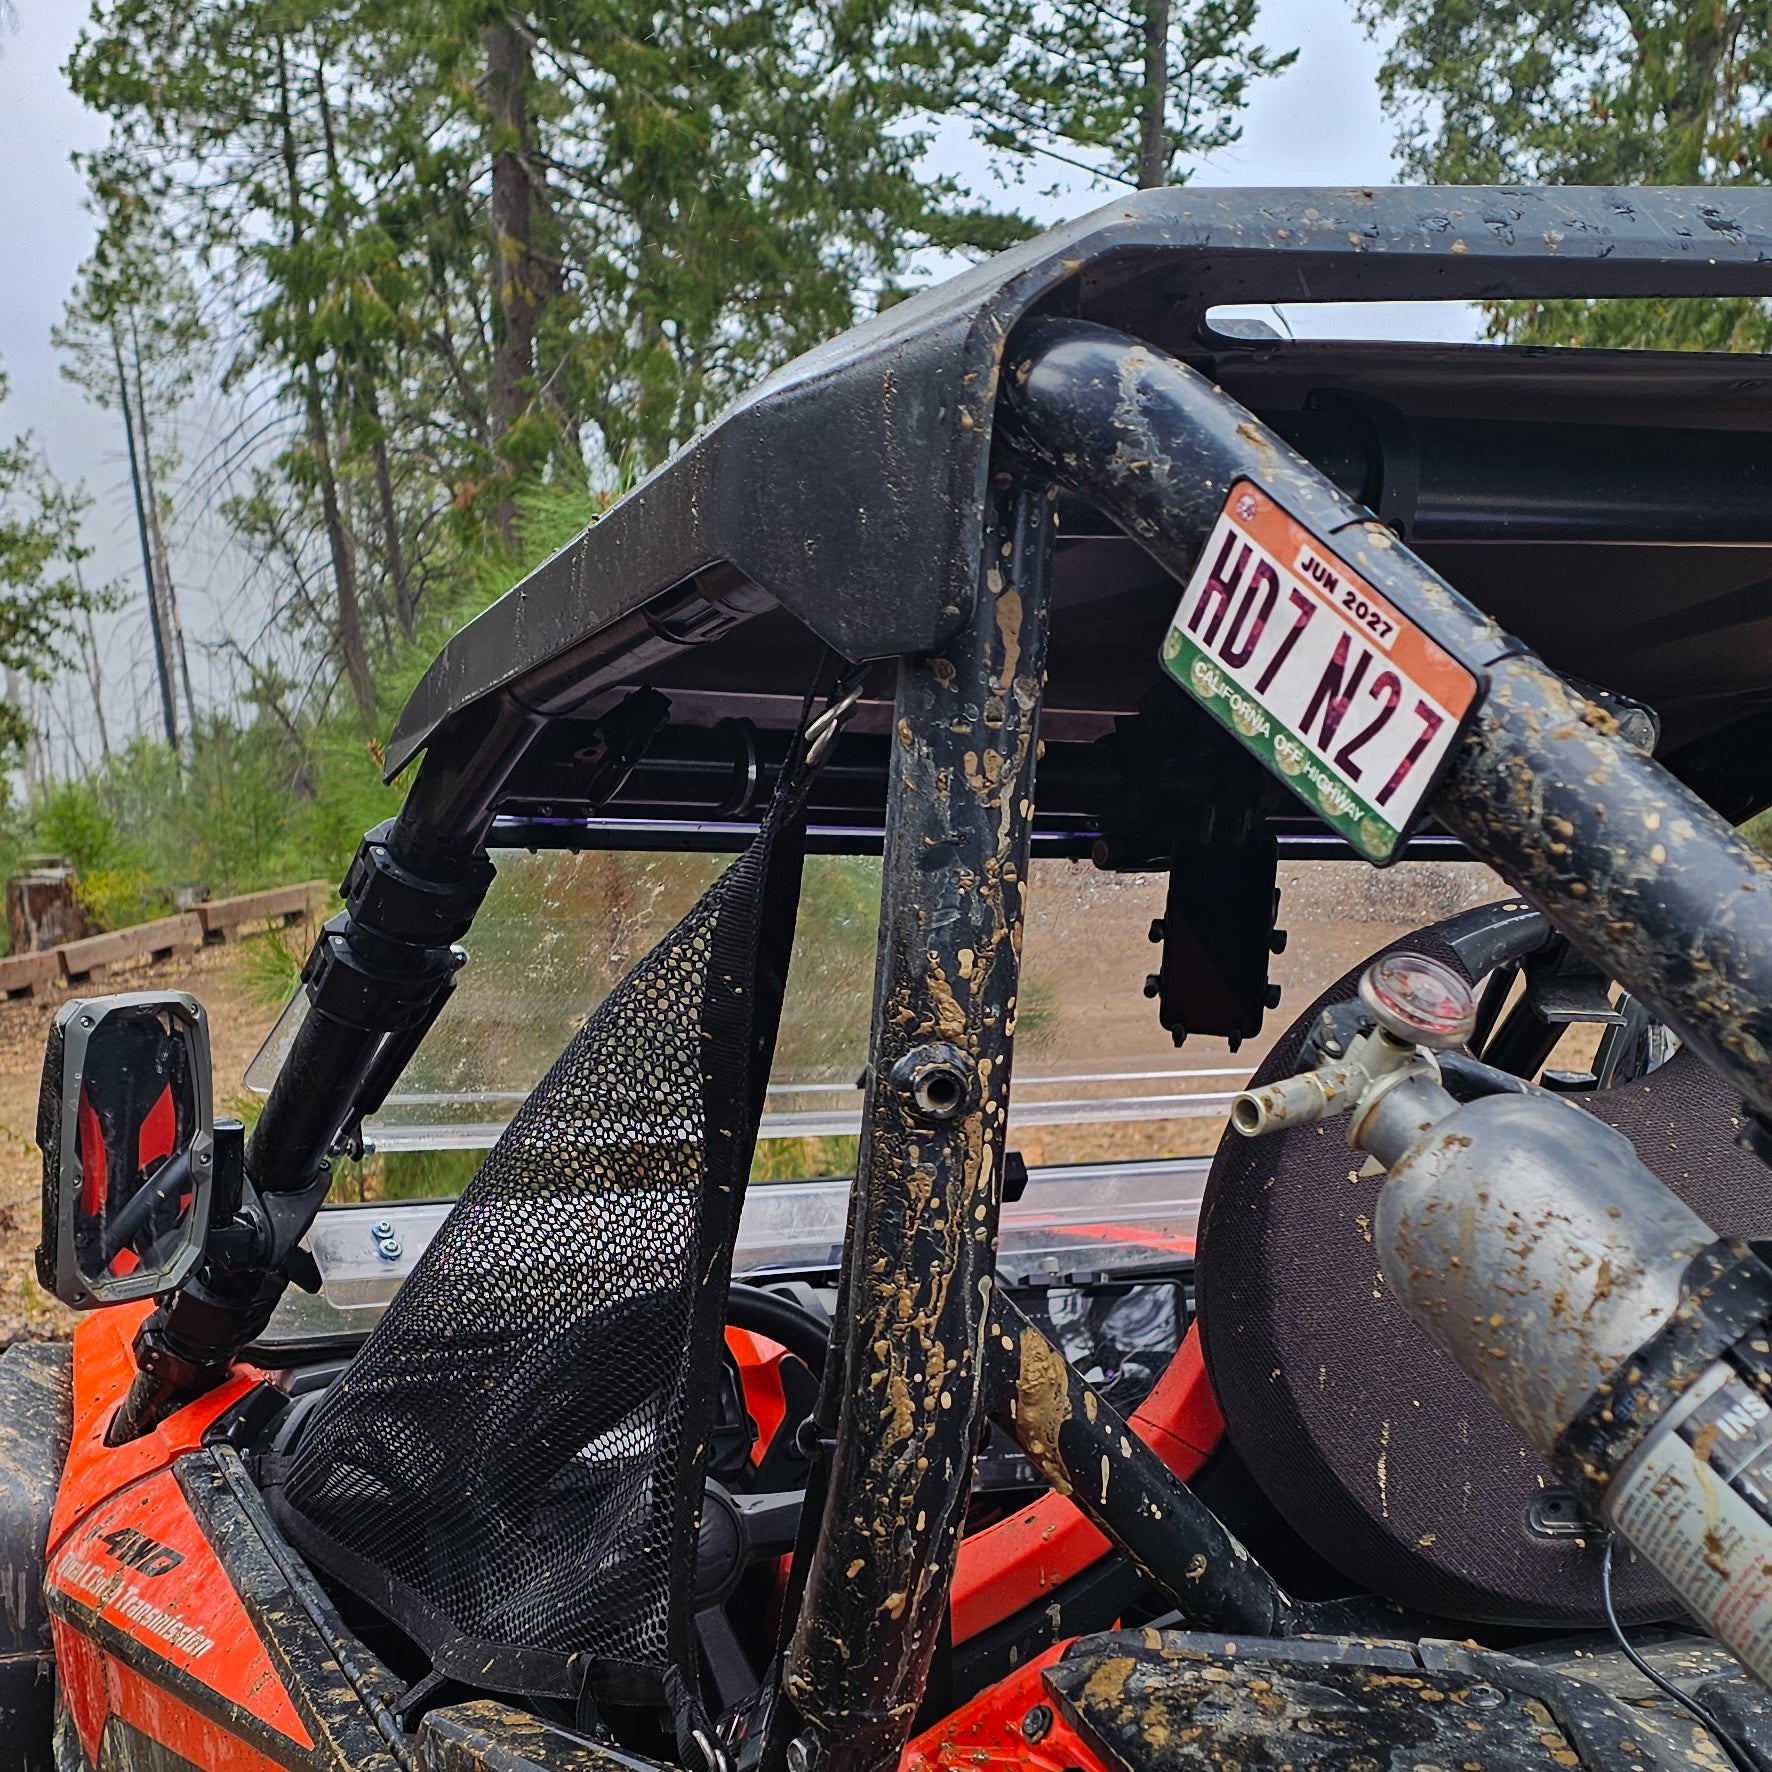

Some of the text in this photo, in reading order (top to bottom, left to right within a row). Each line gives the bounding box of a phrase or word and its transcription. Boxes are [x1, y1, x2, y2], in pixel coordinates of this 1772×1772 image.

[1301, 556, 1393, 638] JUN 2027
[1188, 529, 1445, 807] HD7 N27
[1194, 661, 1365, 822] CALIFORNIA OFF HIGHWAY
[114, 1585, 214, 1658] Transmission
